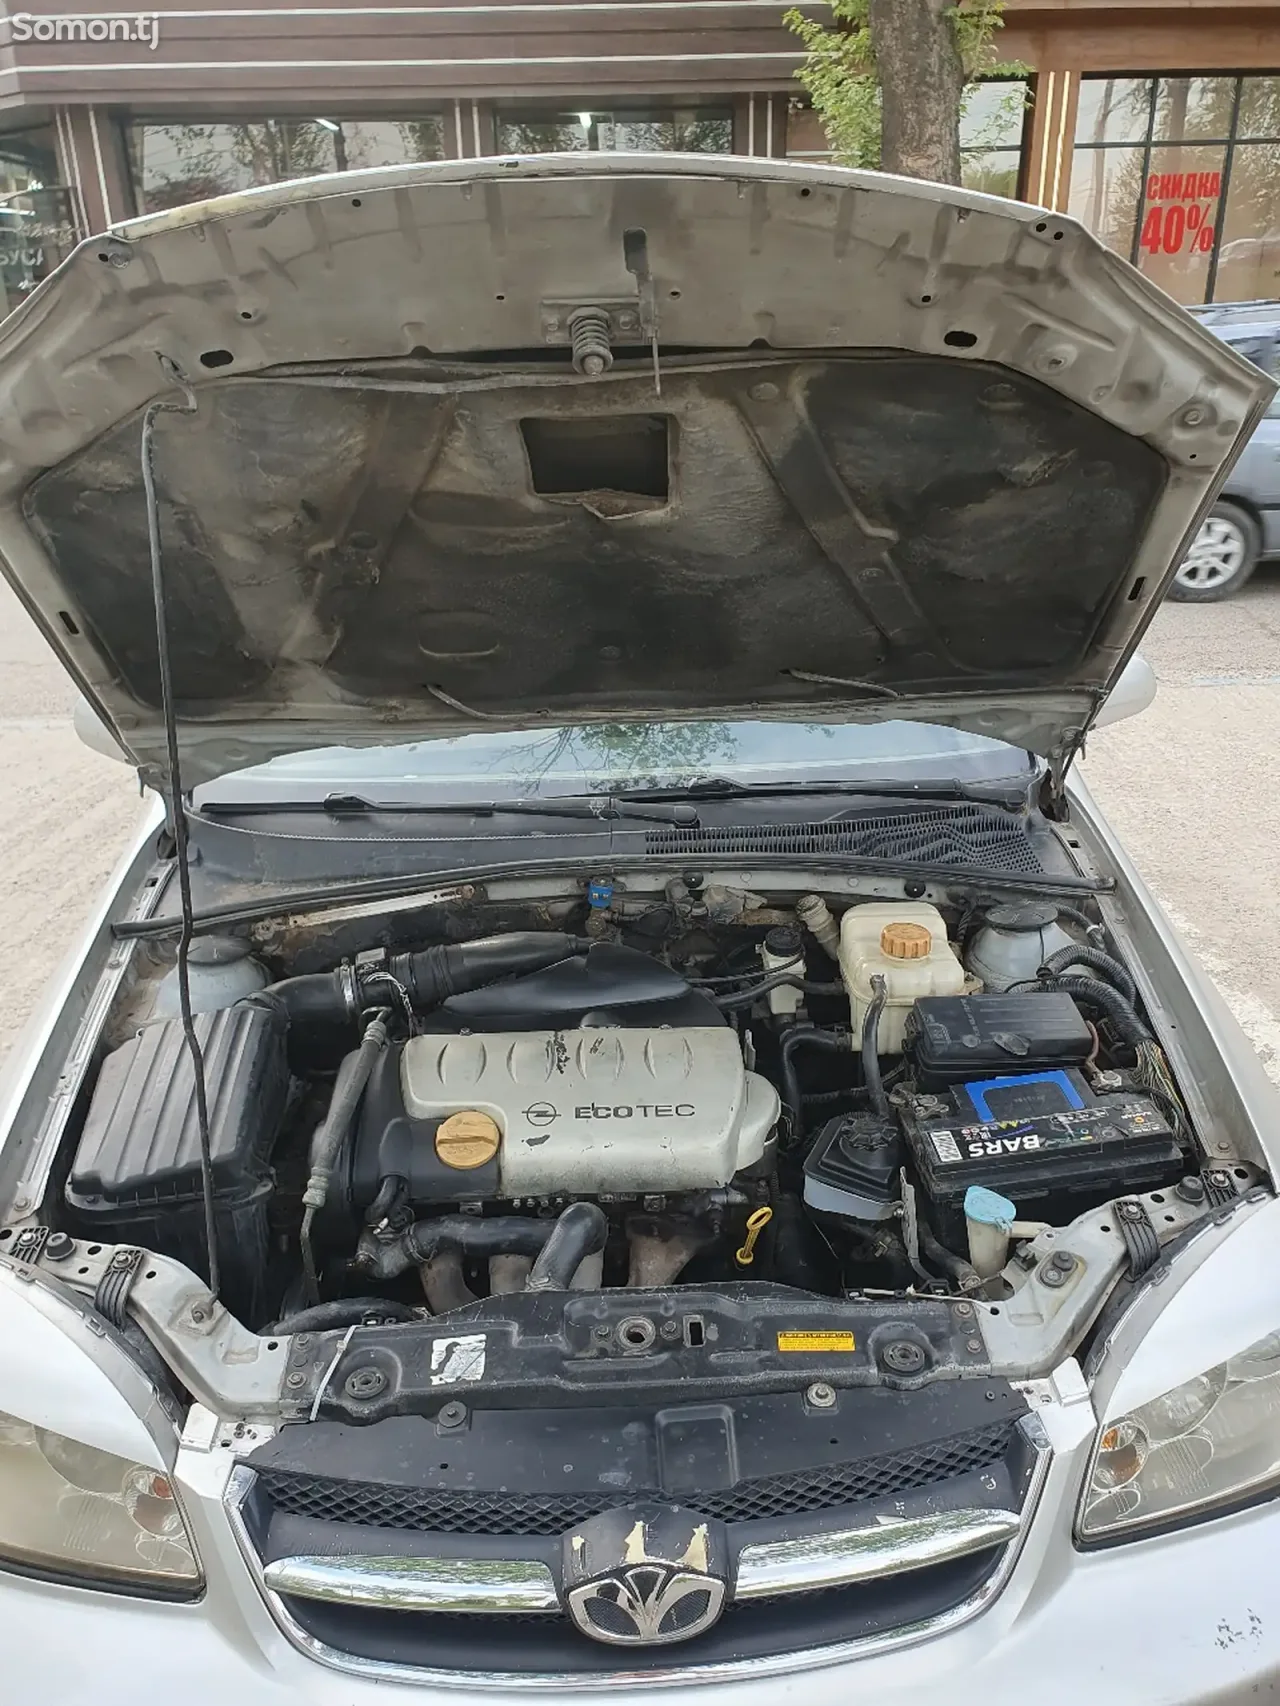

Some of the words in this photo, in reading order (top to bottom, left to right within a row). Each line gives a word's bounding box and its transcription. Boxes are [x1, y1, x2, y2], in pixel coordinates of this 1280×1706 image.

[1146, 171, 1220, 202] СКИДКА
[1140, 203, 1214, 254] 40%
[574, 1103, 696, 1119] ECOTEC
[968, 1134, 1040, 1158] BARS
